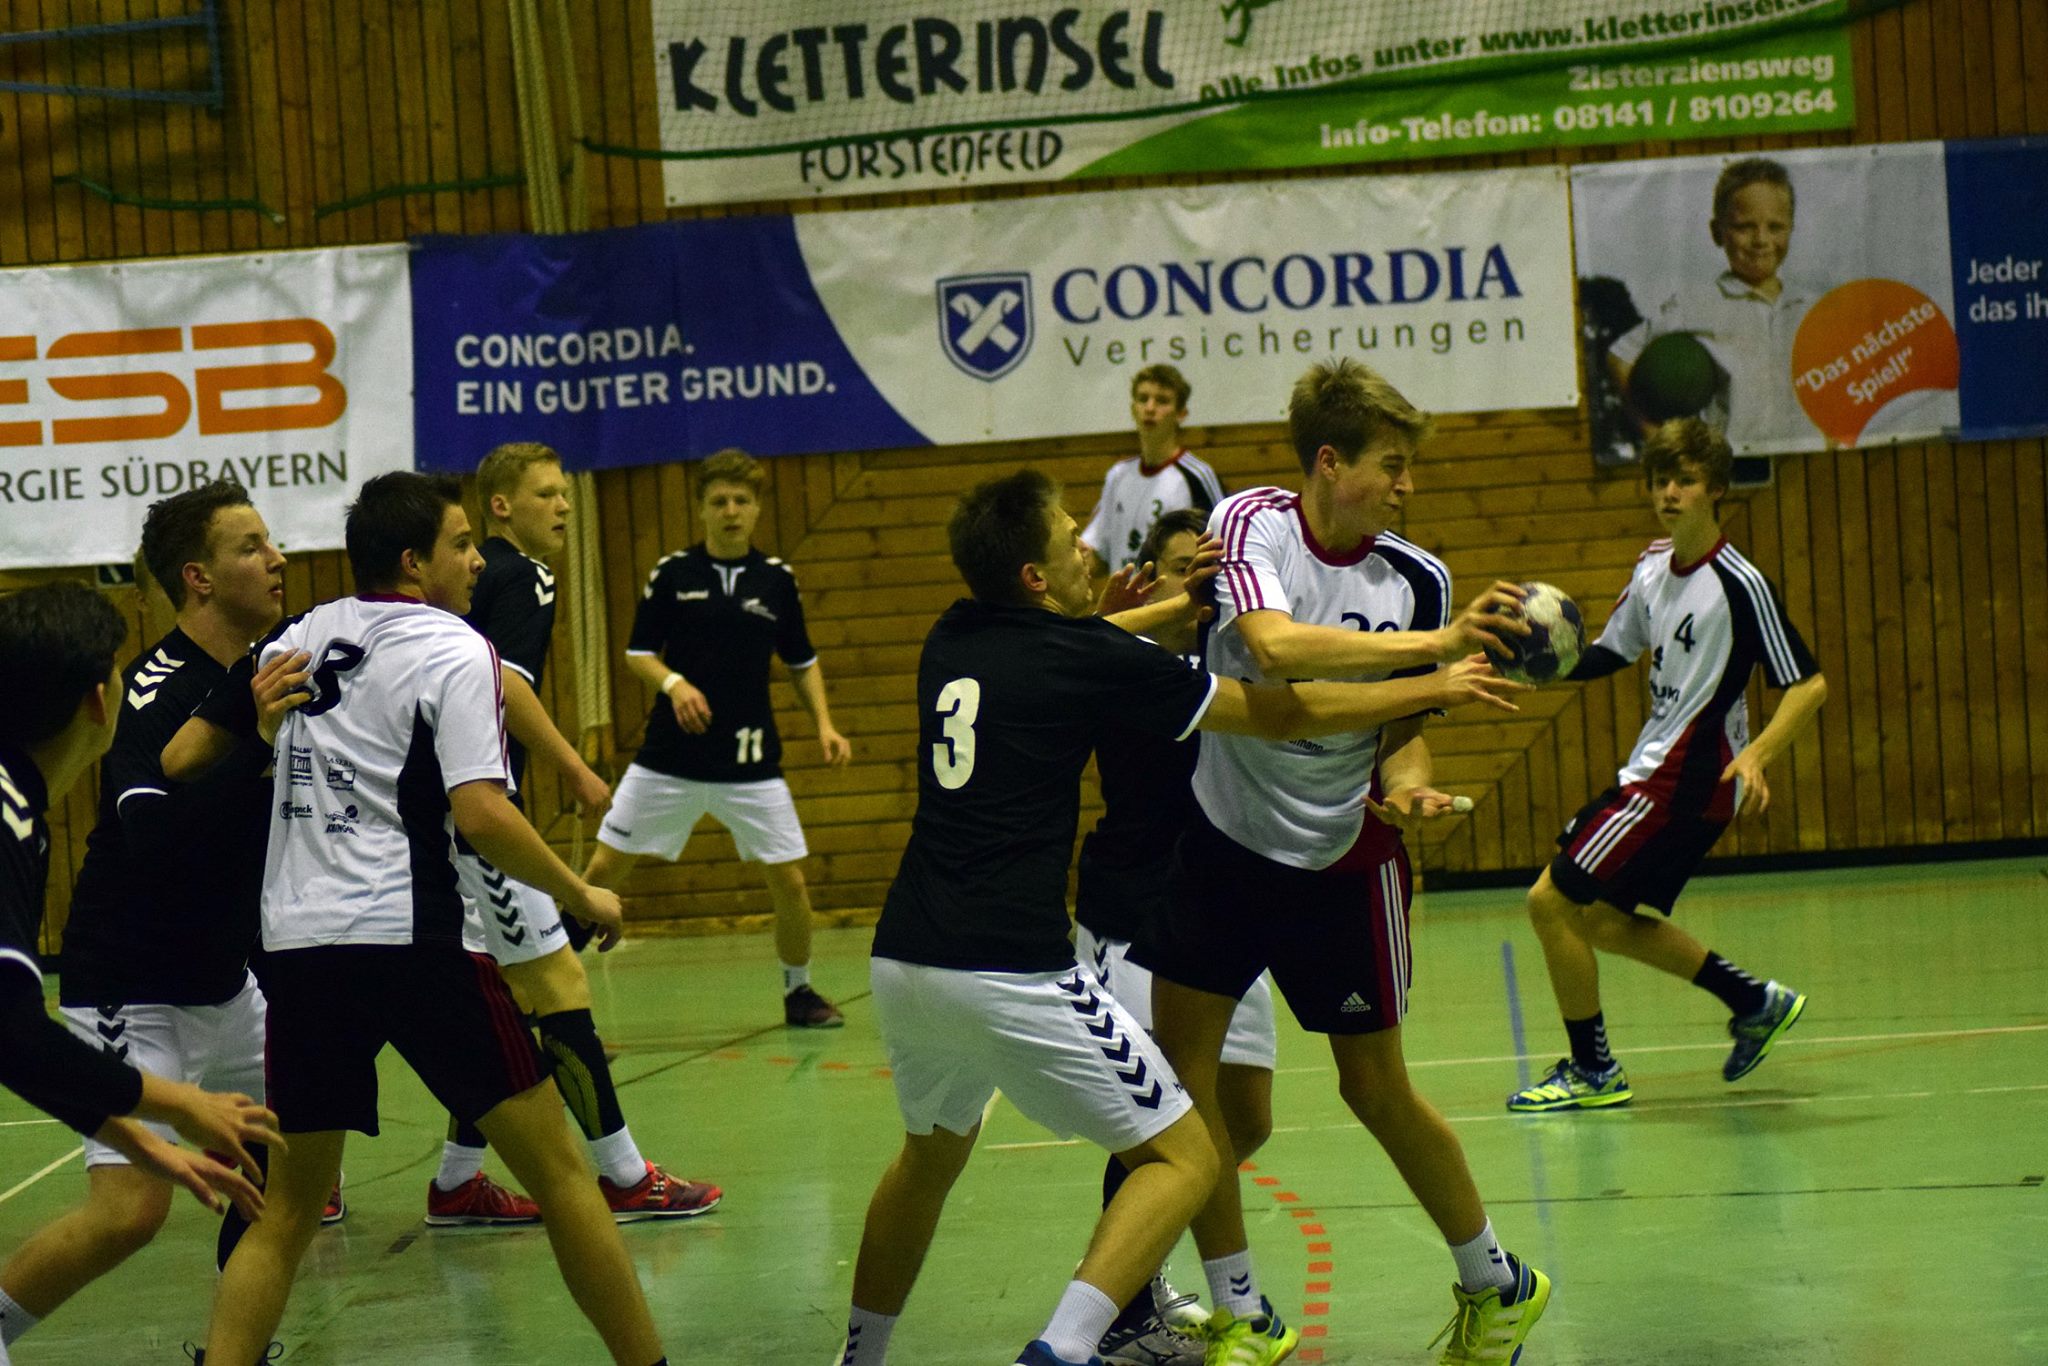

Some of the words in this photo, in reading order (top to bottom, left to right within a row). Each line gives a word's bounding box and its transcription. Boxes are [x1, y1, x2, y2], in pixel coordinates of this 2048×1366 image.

[1274, 53, 1363, 89] Infos
[1374, 36, 1467, 67] unter
[1568, 54, 1835, 91] Zisterziensweg
[1320, 110, 1542, 148] Info-Telefon:
[1553, 99, 1654, 131] 08141
[1689, 87, 1837, 122] 8109264
[1051, 243, 1524, 325] CONCORDIA
[1967, 253, 2043, 285] Jeder
[1851, 301, 1937, 364] nächste
[1969, 294, 2017, 323] das
[455, 324, 695, 368] CONCORDIA.
[1062, 316, 1526, 367] Versicherungen
[456, 380, 522, 415] EIN
[535, 372, 670, 414] GUTER
[682, 361, 836, 401] GRUND.
[101, 450, 349, 498] SÜDBAYERN
[1674, 612, 1696, 654] 4
[735, 726, 764, 764] 11
[932, 677, 981, 790] 3
